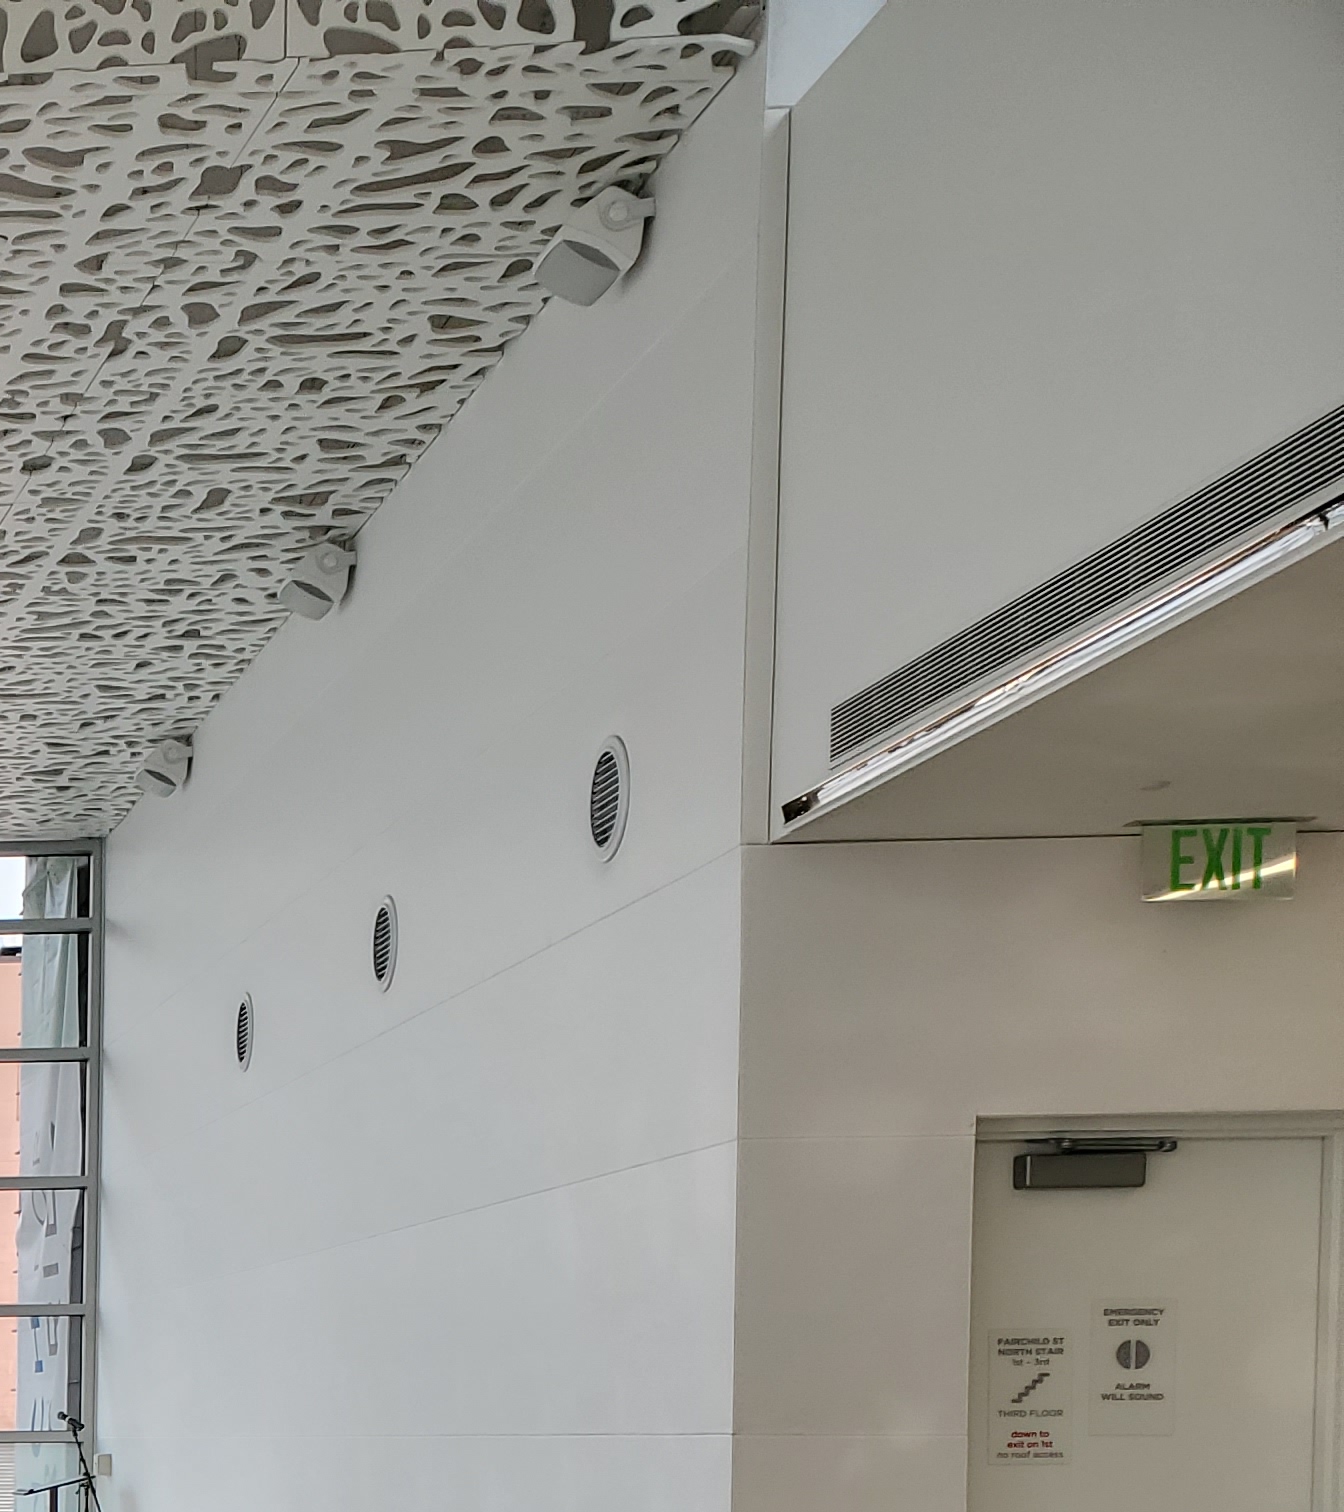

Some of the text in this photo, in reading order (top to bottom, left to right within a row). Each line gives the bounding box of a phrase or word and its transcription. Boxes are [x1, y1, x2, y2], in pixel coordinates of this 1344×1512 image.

[1169, 827, 1272, 891] EXIT
[1103, 1308, 1165, 1316] EMERGENCY
[1108, 1319, 1130, 1327] EXIT
[997, 1337, 1065, 1346] FAIRCHILD ST
[997, 1347, 1064, 1356] NORTH STAIR
[1034, 1358, 1050, 1366] 3rd
[1101, 1393, 1165, 1401] WILL SOUND
[998, 1409, 1064, 1418] THIRD FLOOR
[1011, 1430, 1050, 1438] down to
[1007, 1441, 1024, 1449] exit
[1041, 1440, 1054, 1448] 1st
[1011, 1450, 1031, 1459] roof
